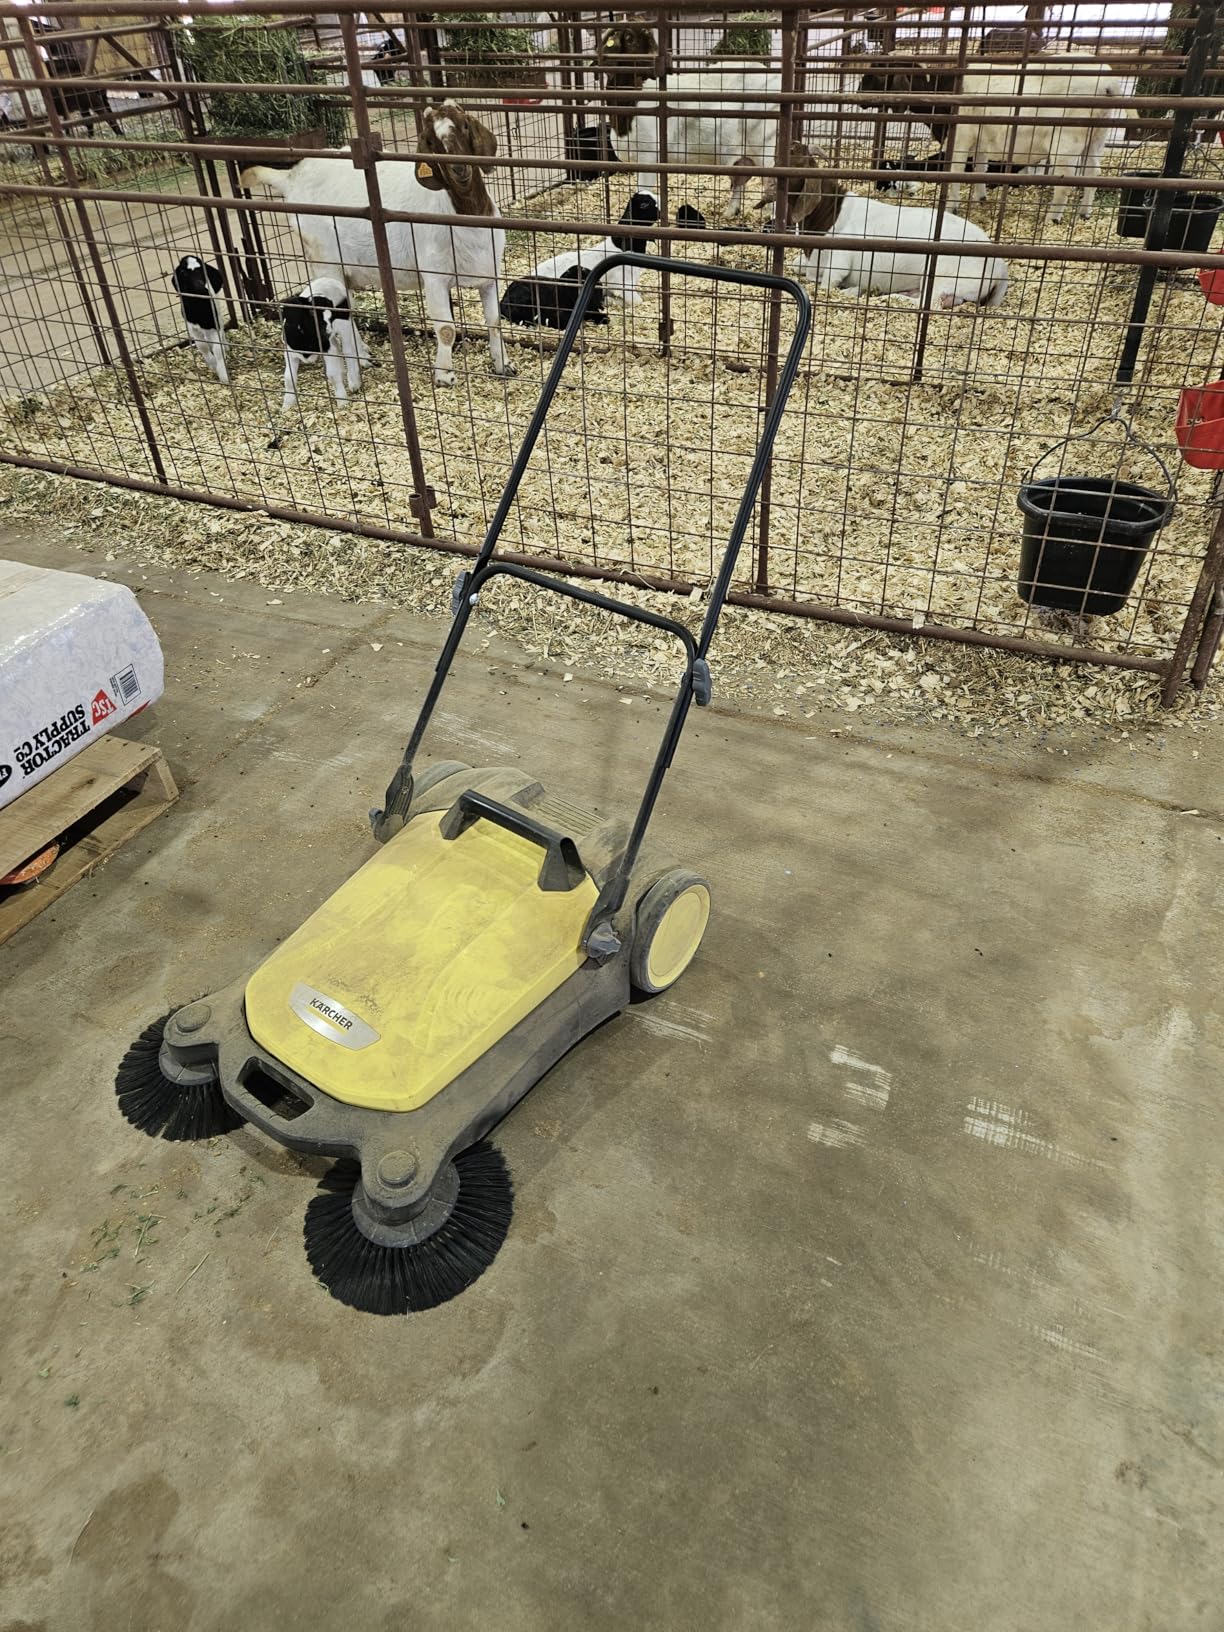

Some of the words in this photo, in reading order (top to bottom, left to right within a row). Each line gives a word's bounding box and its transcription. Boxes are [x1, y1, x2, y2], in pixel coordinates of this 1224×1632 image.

[33, 704, 85, 751] SUPPLY
[92, 699, 114, 717] TSC
[20, 720, 90, 775] TRACTOR
[309, 998, 353, 1031] KÄRCHER
